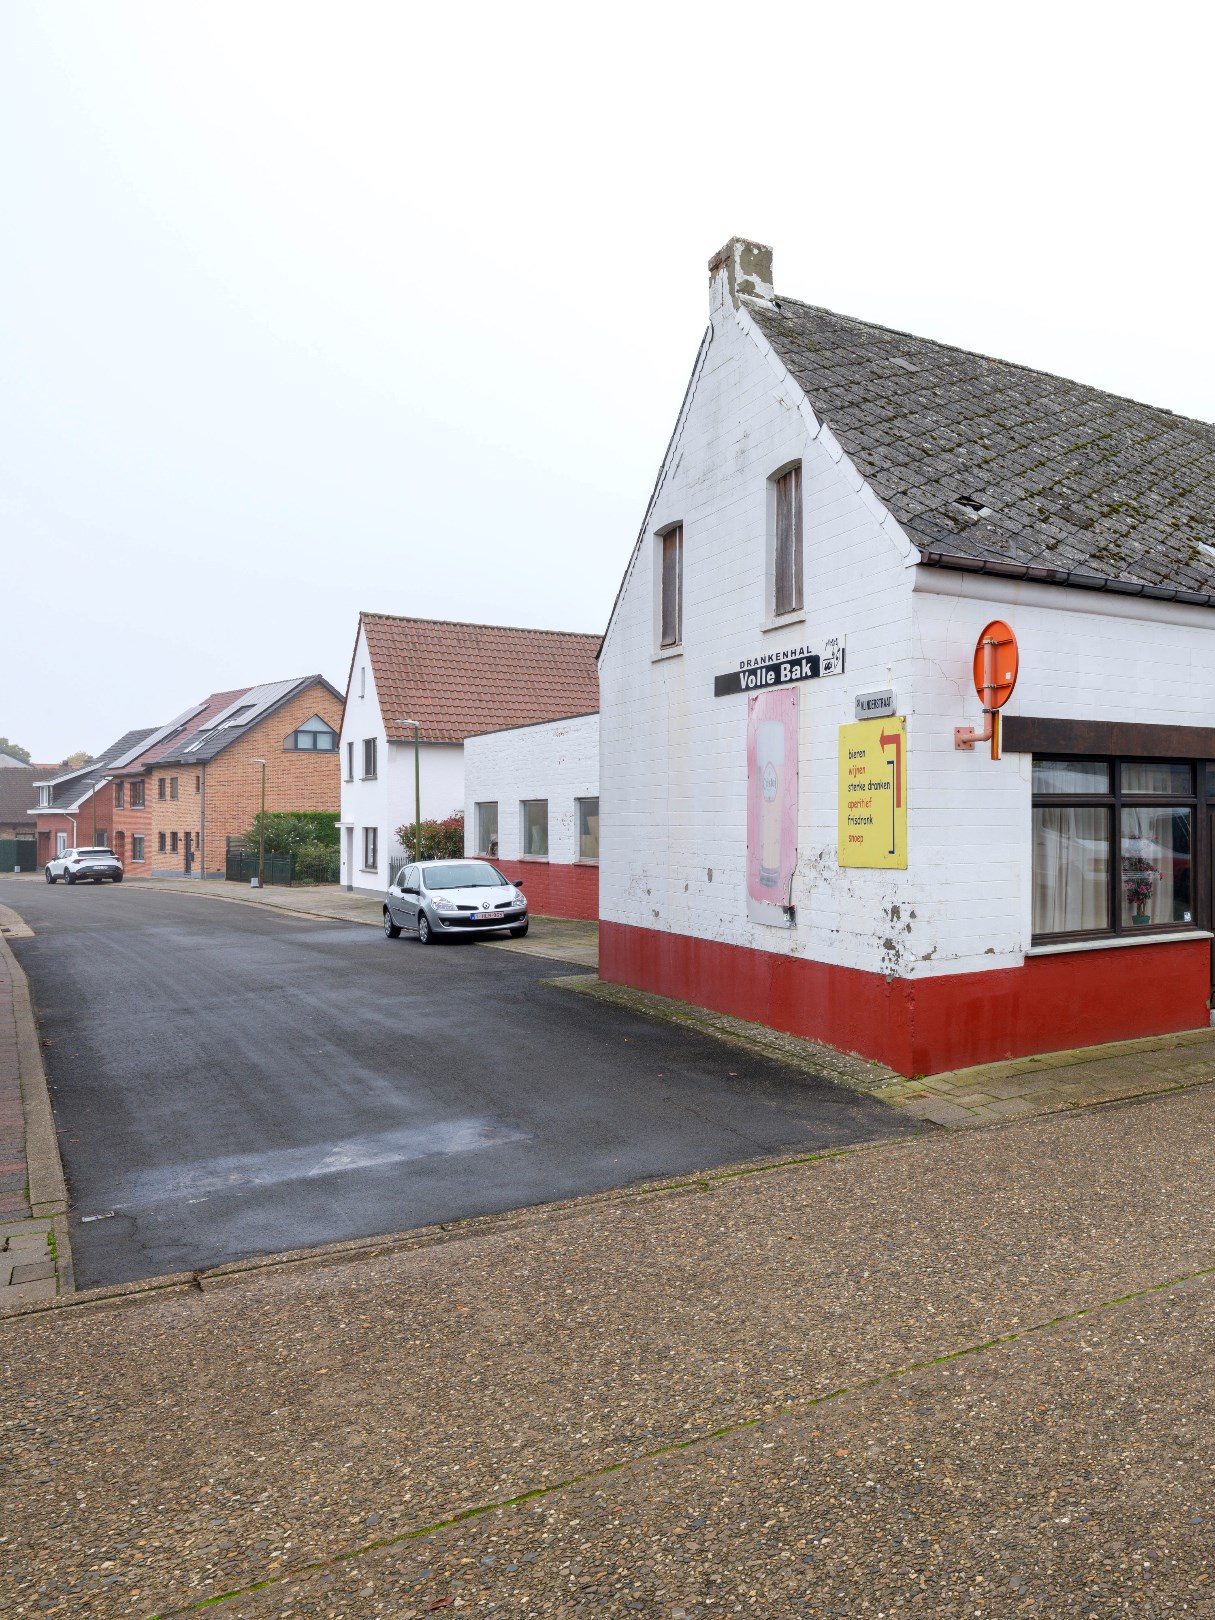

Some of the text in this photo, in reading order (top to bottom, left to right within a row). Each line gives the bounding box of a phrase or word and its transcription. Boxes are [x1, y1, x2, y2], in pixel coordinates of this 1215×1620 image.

[740, 646, 812, 669] DRANKENHAL
[740, 659, 812, 689] Volle Bak
[848, 749, 865, 759] bieren
[848, 765, 865, 778] wijnen
[848, 779, 890, 792] sterke dranken
[848, 797, 872, 811] aperitief
[848, 814, 873, 825] frisdrank
[848, 835, 864, 846] snoep
